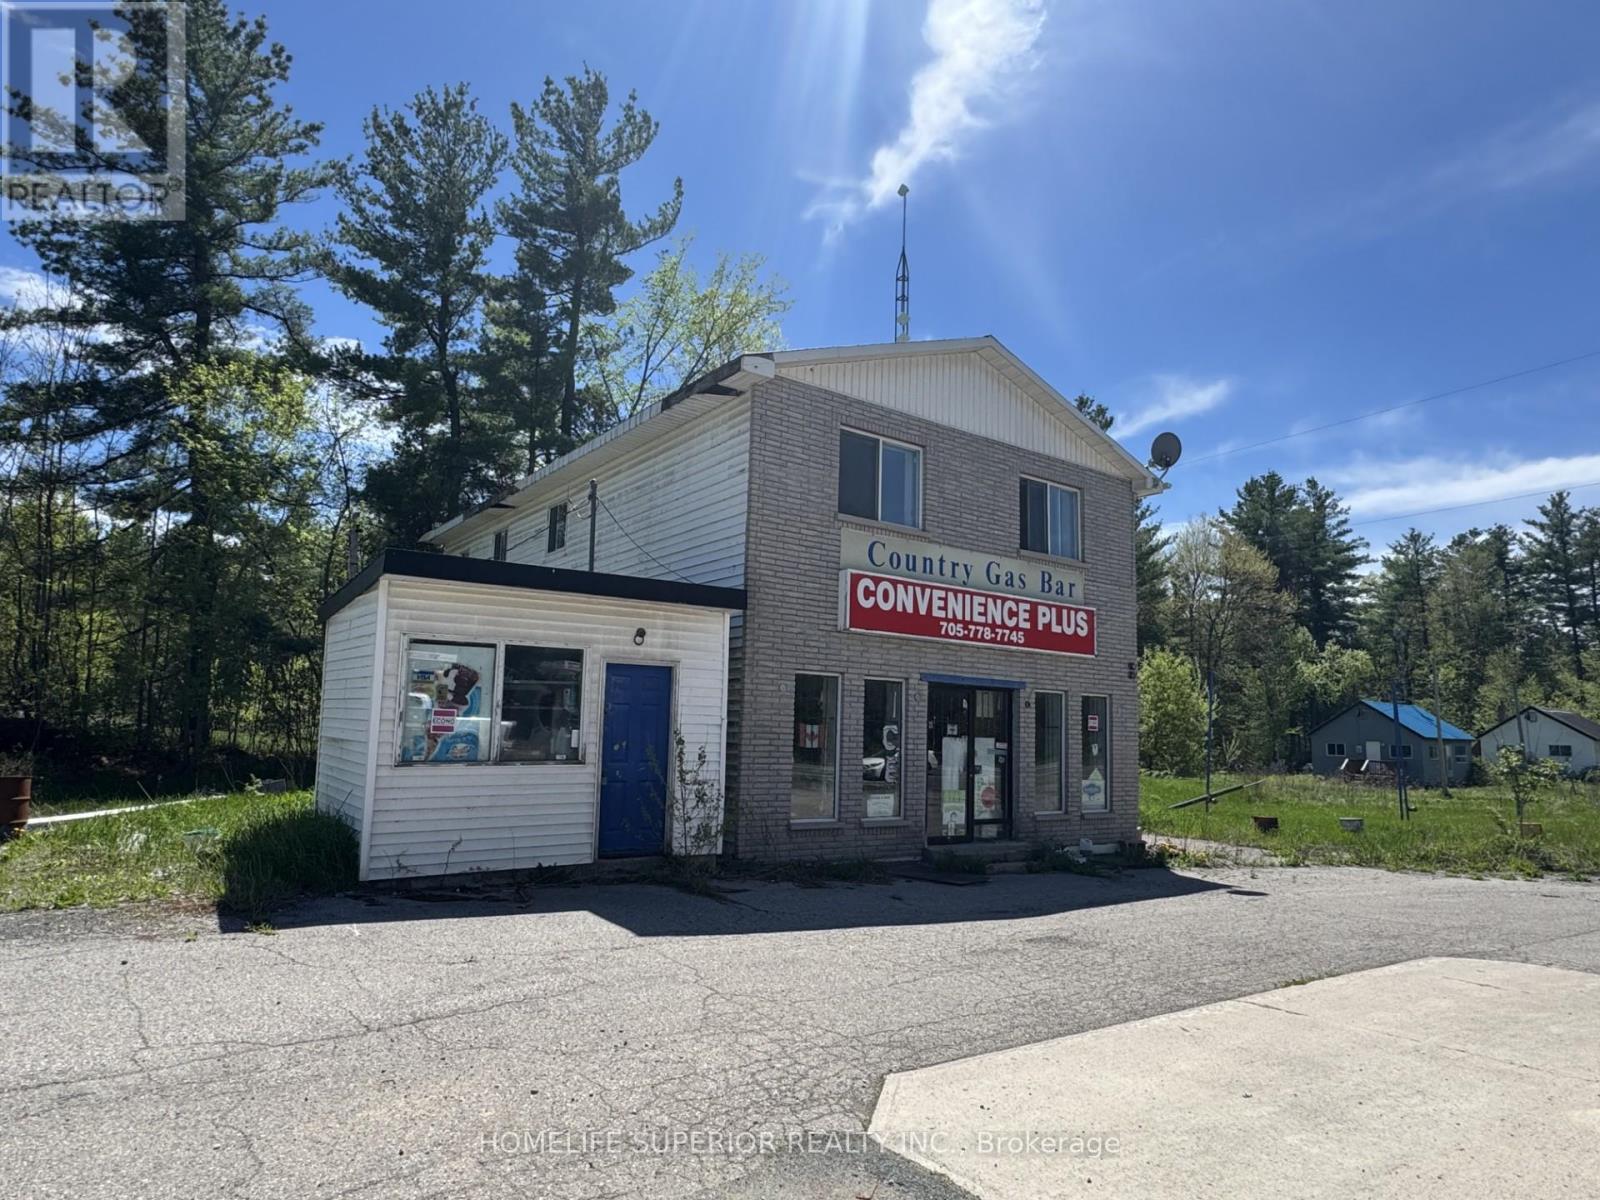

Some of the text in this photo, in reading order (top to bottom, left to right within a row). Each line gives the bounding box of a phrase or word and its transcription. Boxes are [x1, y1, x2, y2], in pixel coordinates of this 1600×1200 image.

[867, 540, 1076, 598] Country Gas Bar
[856, 578, 1089, 637] CONVENIENCE PLUS
[939, 621, 1025, 645] 705-778-7745
